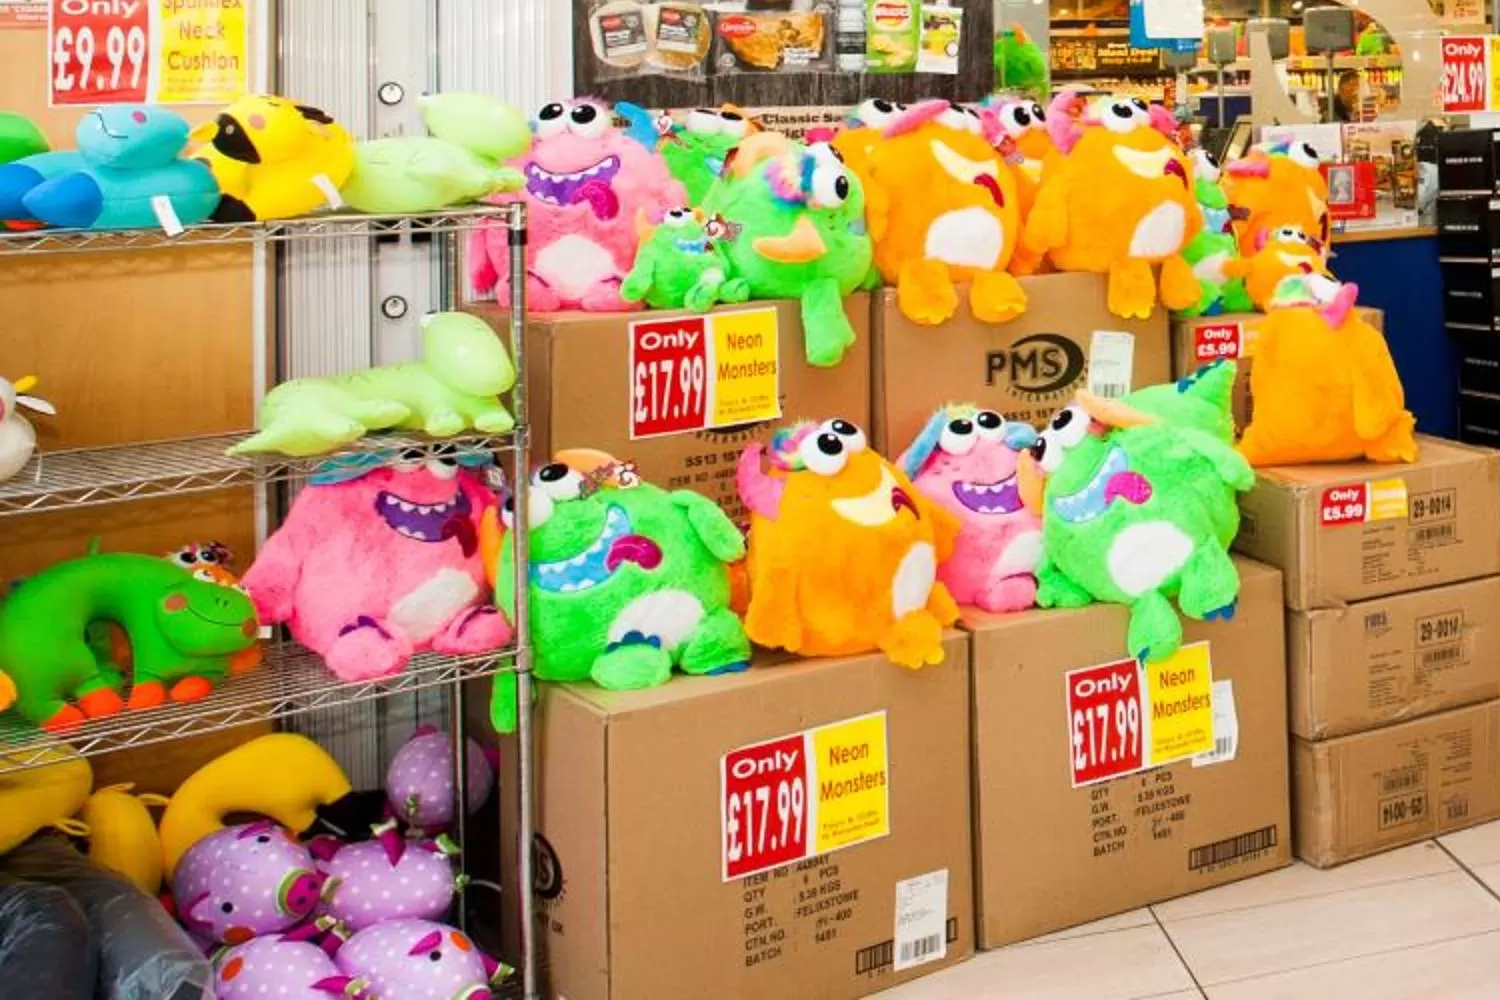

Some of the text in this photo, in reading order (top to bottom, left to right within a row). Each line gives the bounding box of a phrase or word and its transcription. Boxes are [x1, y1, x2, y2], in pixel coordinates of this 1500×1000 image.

[53, 21, 226, 91] £9.99 Neck
[167, 50, 239, 71] Cushion
[1445, 43, 1482, 57] Only
[761, 113, 820, 124] Classic
[640, 328, 763, 351] Only Neon
[1204, 328, 1232, 339] Only
[1197, 341, 1236, 357] £5.99
[985, 348, 1060, 386] PMS
[634, 355, 704, 423] £17.99
[718, 360, 777, 381] Monsters
[1330, 489, 1359, 502] Only
[1323, 504, 1364, 521] £5.99
[1413, 496, 1451, 519] 29-0014
[1075, 668, 1195, 698] Only Neon
[1073, 696, 1139, 771] £17.99
[1153, 692, 1211, 720] Monsters
[732, 741, 869, 779] Only Neon
[727, 776, 804, 862] £17.99
[820, 769, 887, 802] Monsters
[1093, 841, 1125, 857] BATCH
[744, 887, 766, 902] QTY
[745, 946, 782, 967] BATCH
